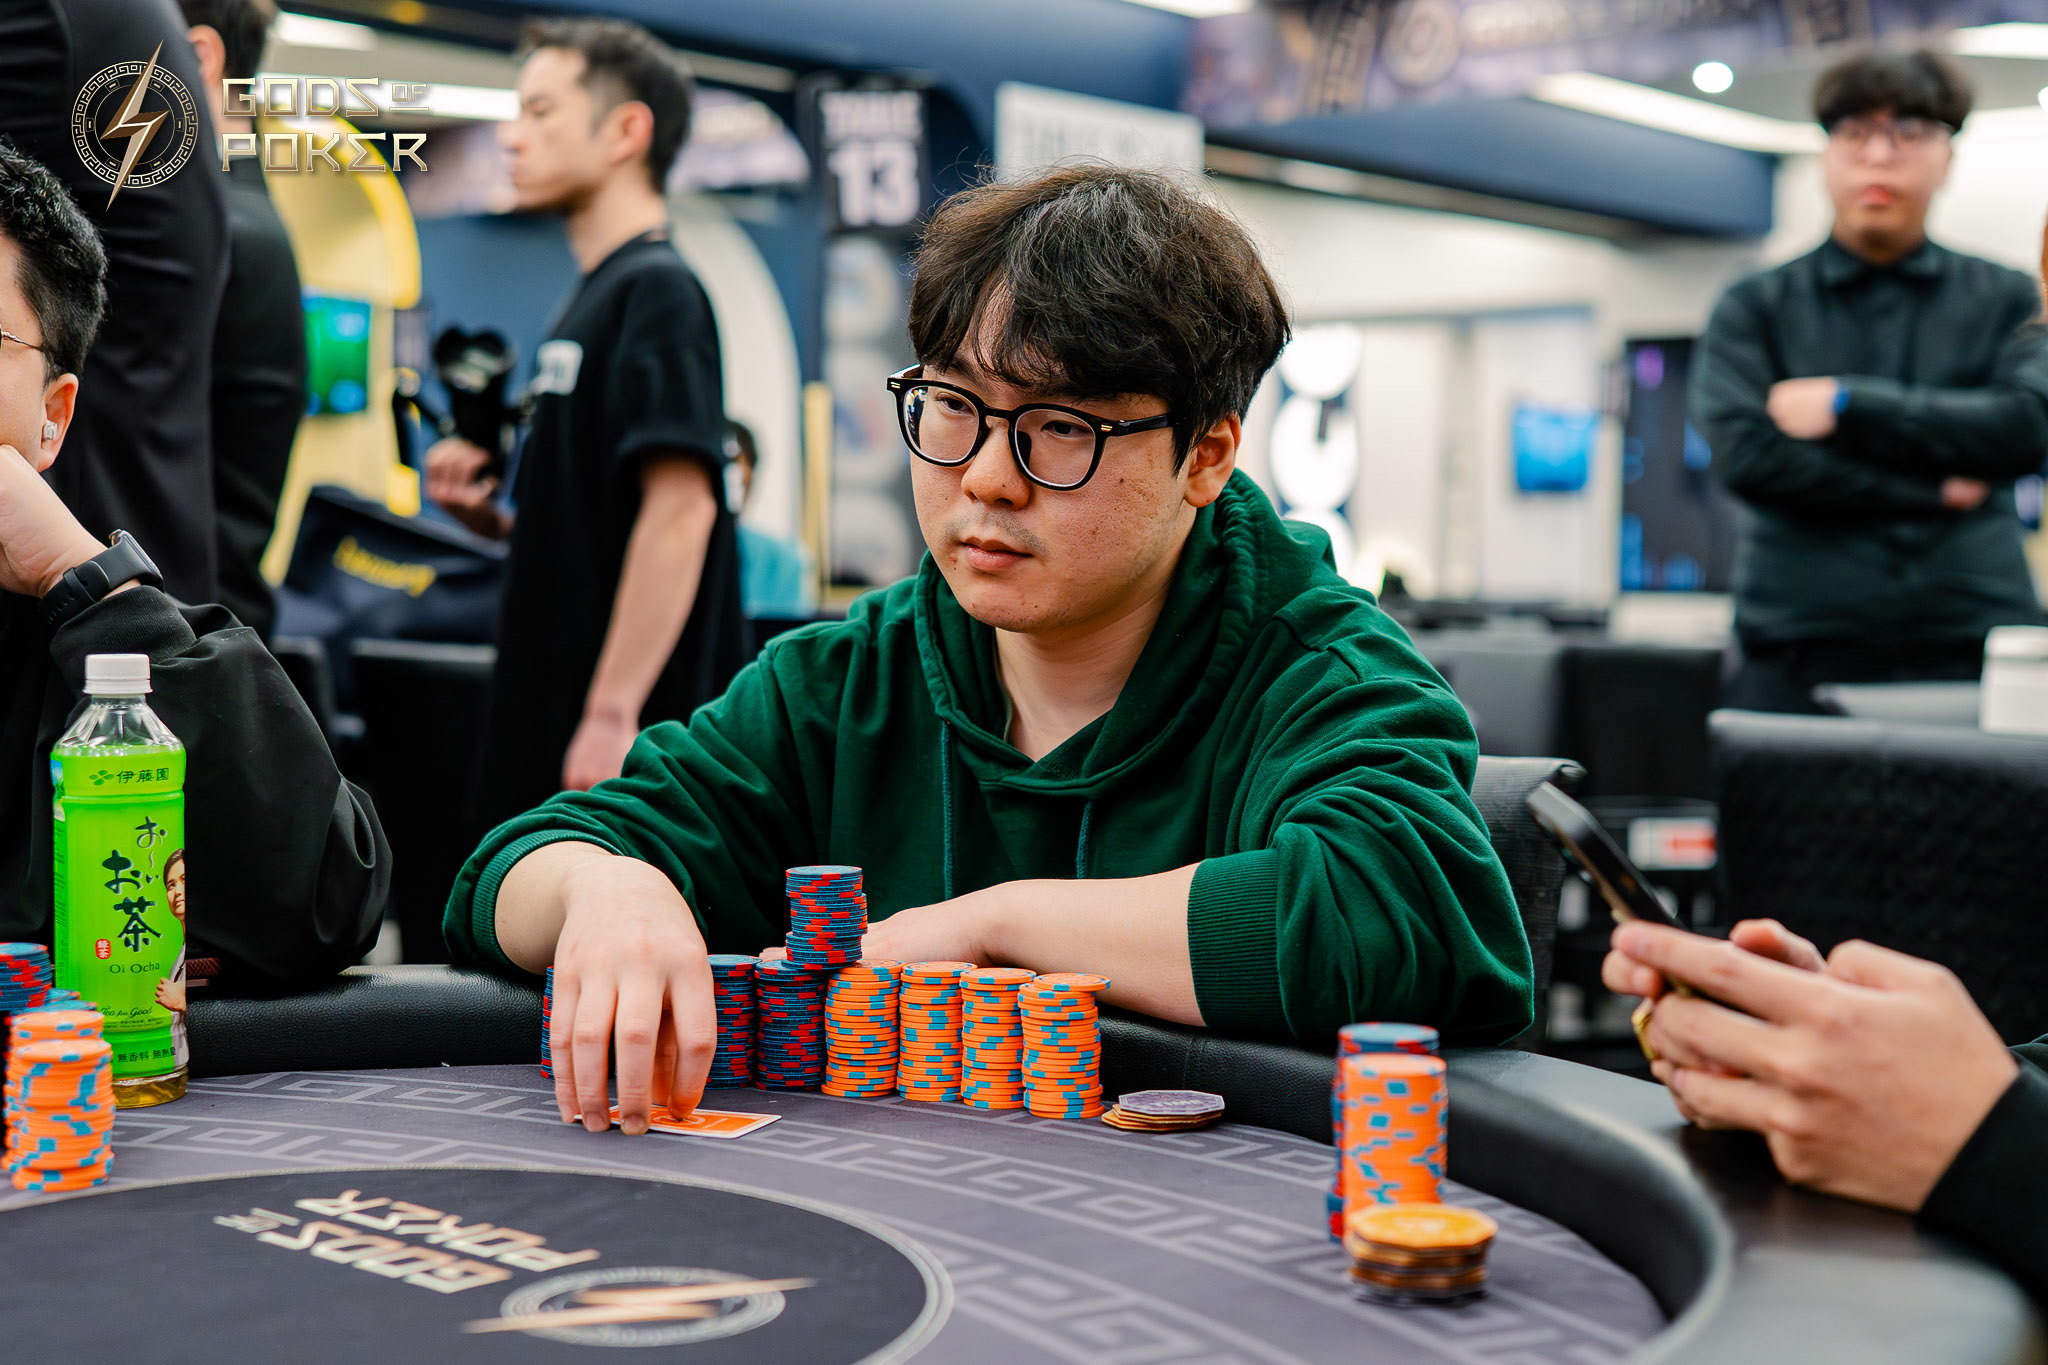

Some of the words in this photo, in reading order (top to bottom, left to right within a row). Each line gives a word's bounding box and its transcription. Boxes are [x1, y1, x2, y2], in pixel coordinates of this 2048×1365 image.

[827, 141, 921, 226] 13
[117, 767, 169, 784] 伊藤園
[102, 849, 162, 952] お茶
[109, 963, 125, 974] Oi
[130, 961, 160, 974] Ocha
[101, 1006, 115, 1016] Tea
[130, 1005, 152, 1018] Good
[257, 1221, 513, 1294] GODS
[295, 1189, 600, 1273] POKER
